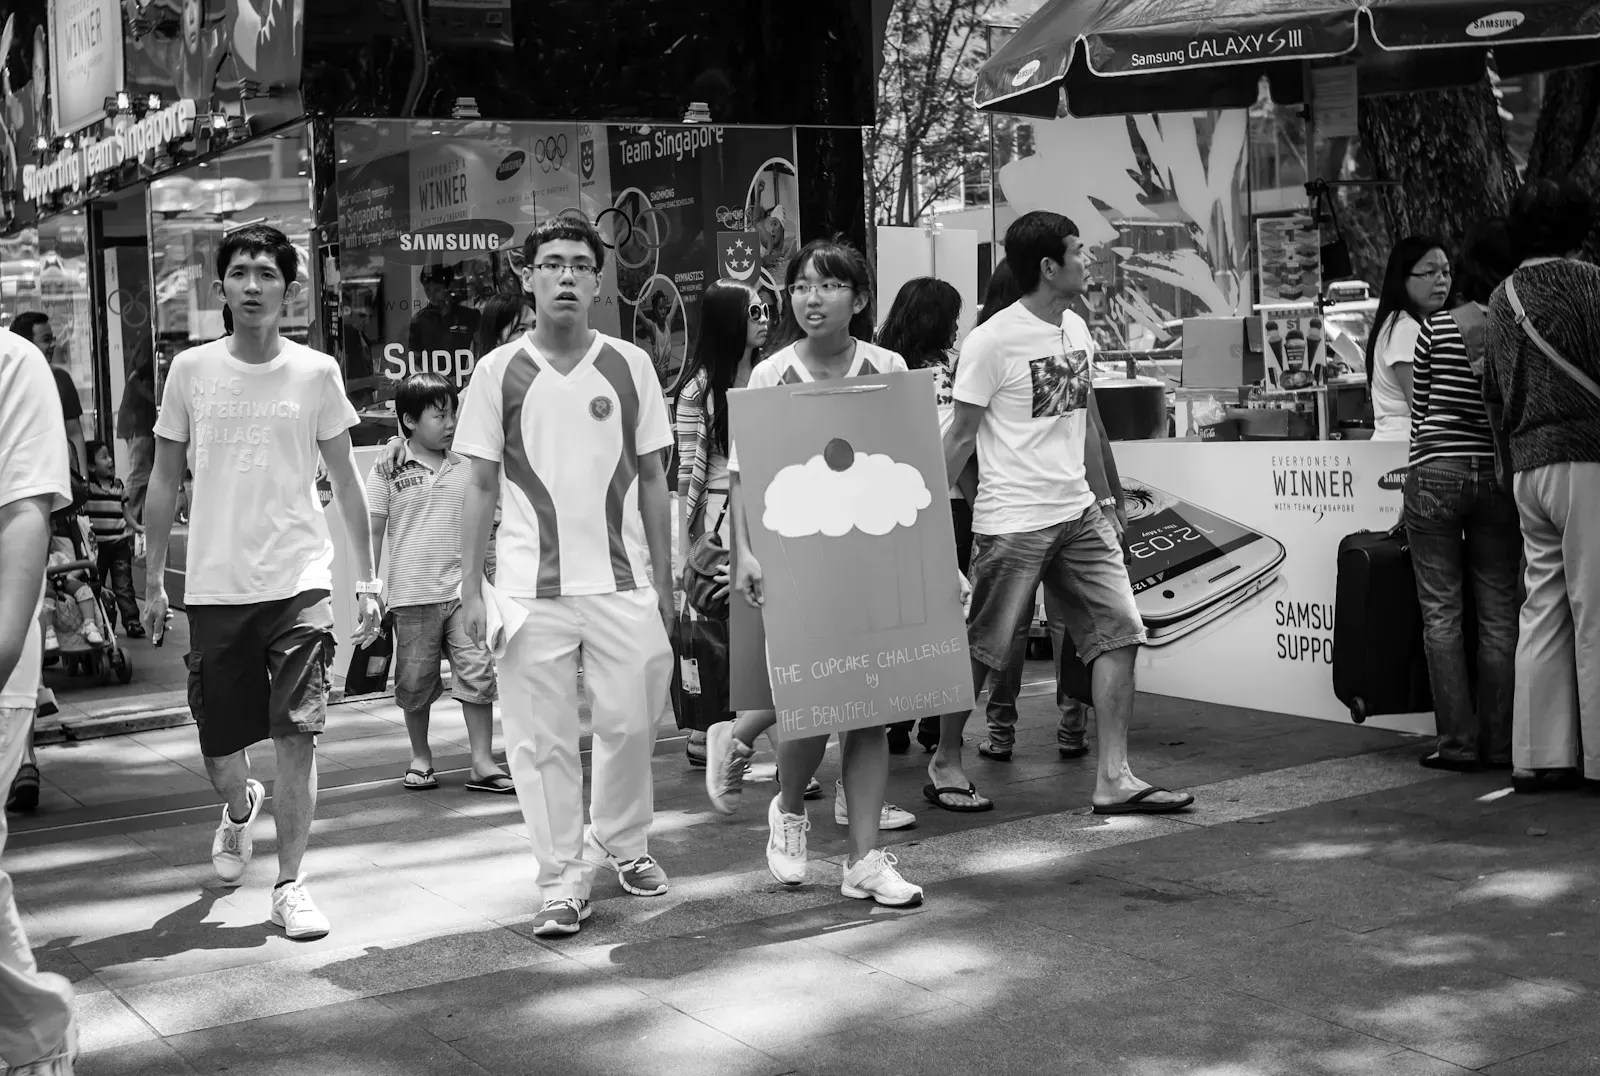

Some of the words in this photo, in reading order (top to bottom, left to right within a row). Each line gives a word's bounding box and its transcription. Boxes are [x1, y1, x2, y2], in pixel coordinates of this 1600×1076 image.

[64, 7, 102, 62] WINNER
[1473, 18, 1518, 29] SAMSUNG
[1131, 49, 1185, 67] Samsung
[1188, 33, 1264, 59] GALAXY
[23, 151, 82, 206] Supporting
[83, 137, 114, 177] Team
[116, 100, 187, 164] Singapore
[619, 139, 652, 165] Team
[654, 126, 724, 161] Singapore
[418, 173, 468, 212] WINNER
[347, 204, 384, 231] Singapore
[400, 233, 500, 251] SAMSUNG
[674, 270, 704, 283] GYMNASTICS
[1272, 455, 1340, 467] EVERYONE'S
[1346, 456, 1352, 466] A
[1272, 469, 1354, 498] WINNER
[1383, 473, 1408, 483] SAMS
[1274, 502, 1291, 511] WITH
[1294, 502, 1311, 512] TEAM
[1128, 523, 1215, 559] 12:03
[1275, 600, 1333, 631] SAMSU
[774, 664, 803, 685] THE
[811, 654, 870, 679] CUPCAKE
[877, 637, 961, 668] CHALLENGE
[1276, 633, 1334, 665] SUPPO
[866, 673, 879, 688] by
[779, 708, 807, 732] THE
[811, 701, 878, 728] BEAUTIFUL
[889, 685, 962, 713] MOVEMENT
